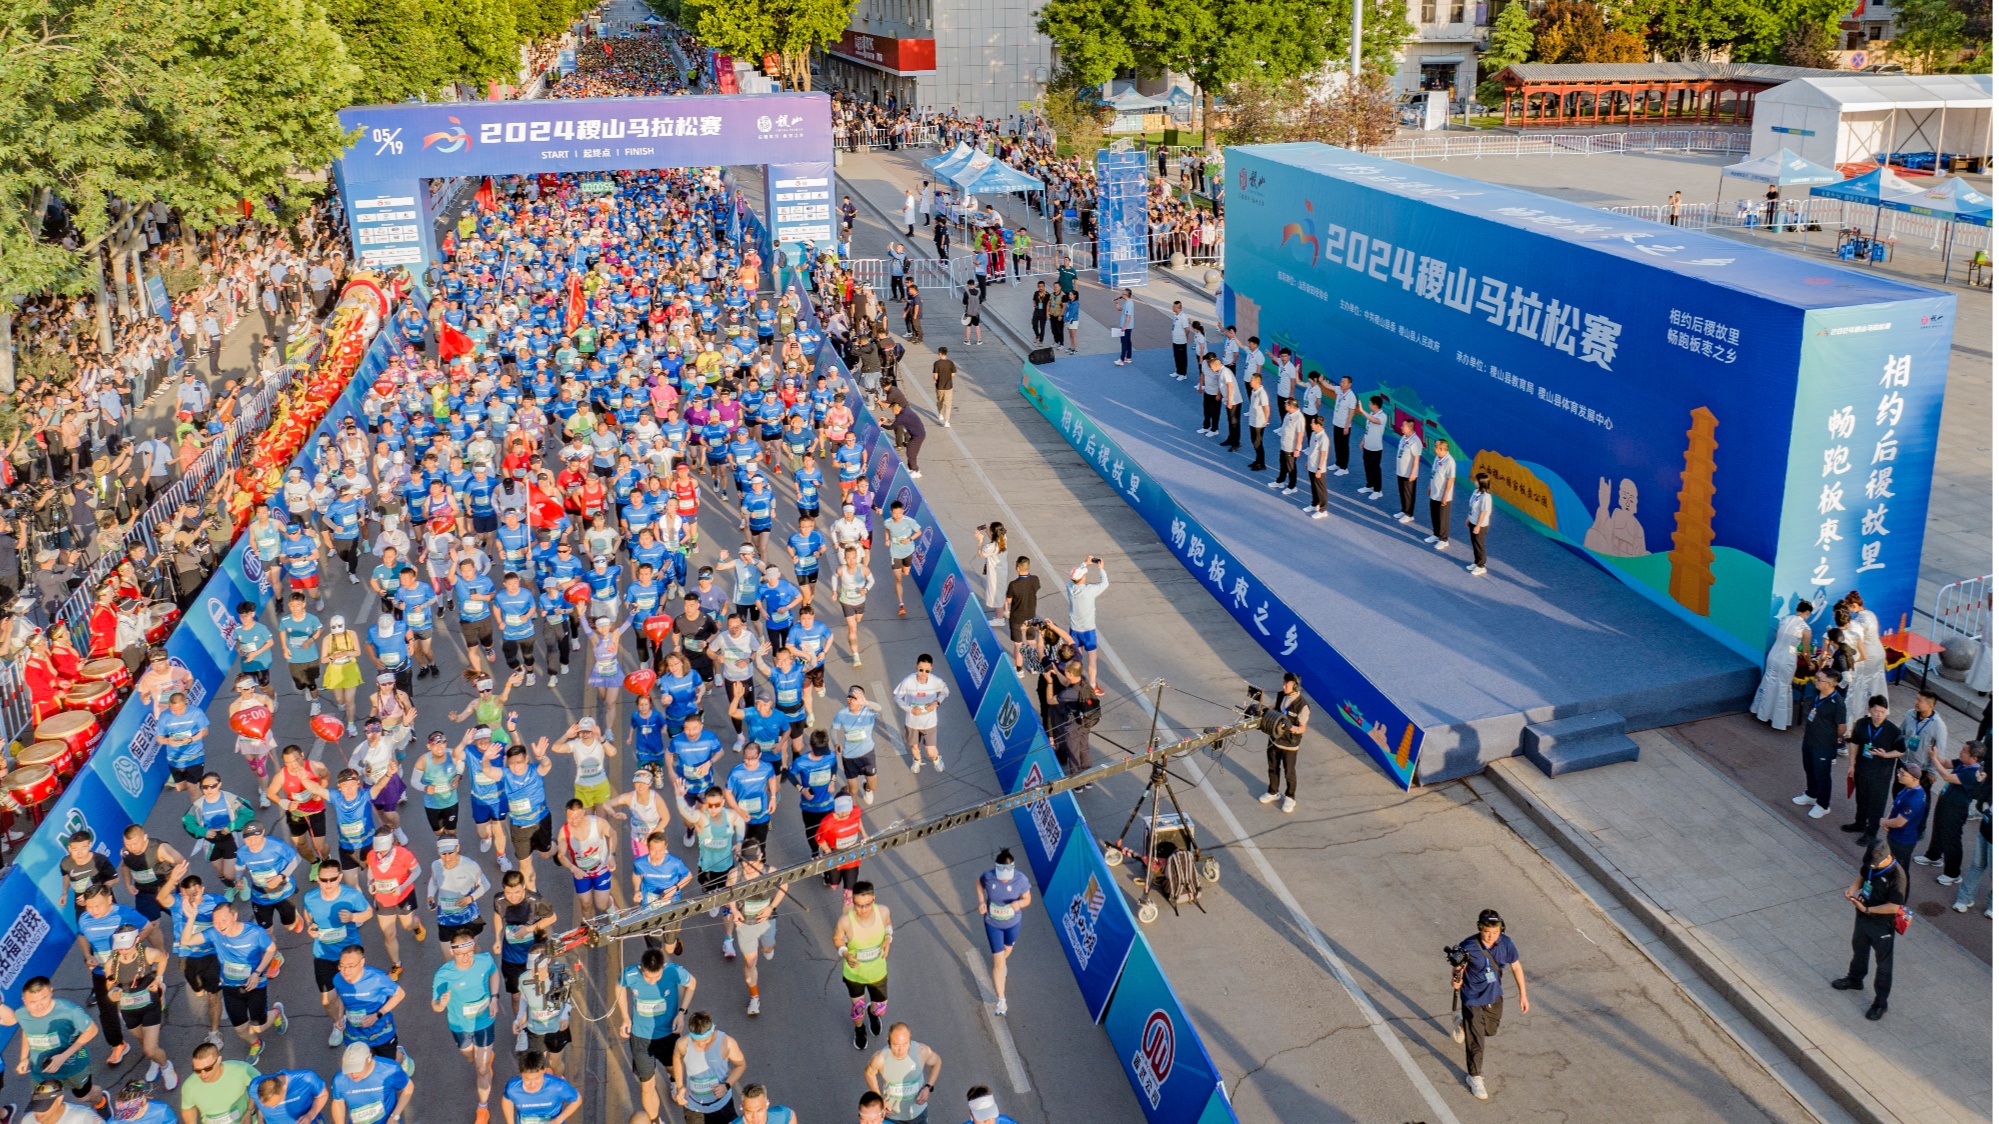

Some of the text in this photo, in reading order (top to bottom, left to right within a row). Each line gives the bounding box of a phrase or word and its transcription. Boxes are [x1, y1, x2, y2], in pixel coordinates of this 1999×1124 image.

[480, 115, 722, 145] 2024稷山马拉松赛
[541, 147, 655, 160] START 起终点 FINISH
[1325, 223, 1623, 372] 2024稷山马拉松赛
[1667, 327, 1738, 364] 畅跑板枣之乡
[1669, 307, 1740, 346] 相约后稷故里
[1537, 386, 1614, 431] 稷山县体育发展中心
[1060, 404, 1141, 503] 相约后稷故里
[1856, 354, 1912, 574] 相约后稷故里
[1808, 405, 1857, 625] 畅跑板枣之乡
[1170, 516, 1299, 656] 畅跑板枣之乡
[239, 709, 267, 725] 2:00
[2, 922, 49, 988] MINGFUGANGTIE
